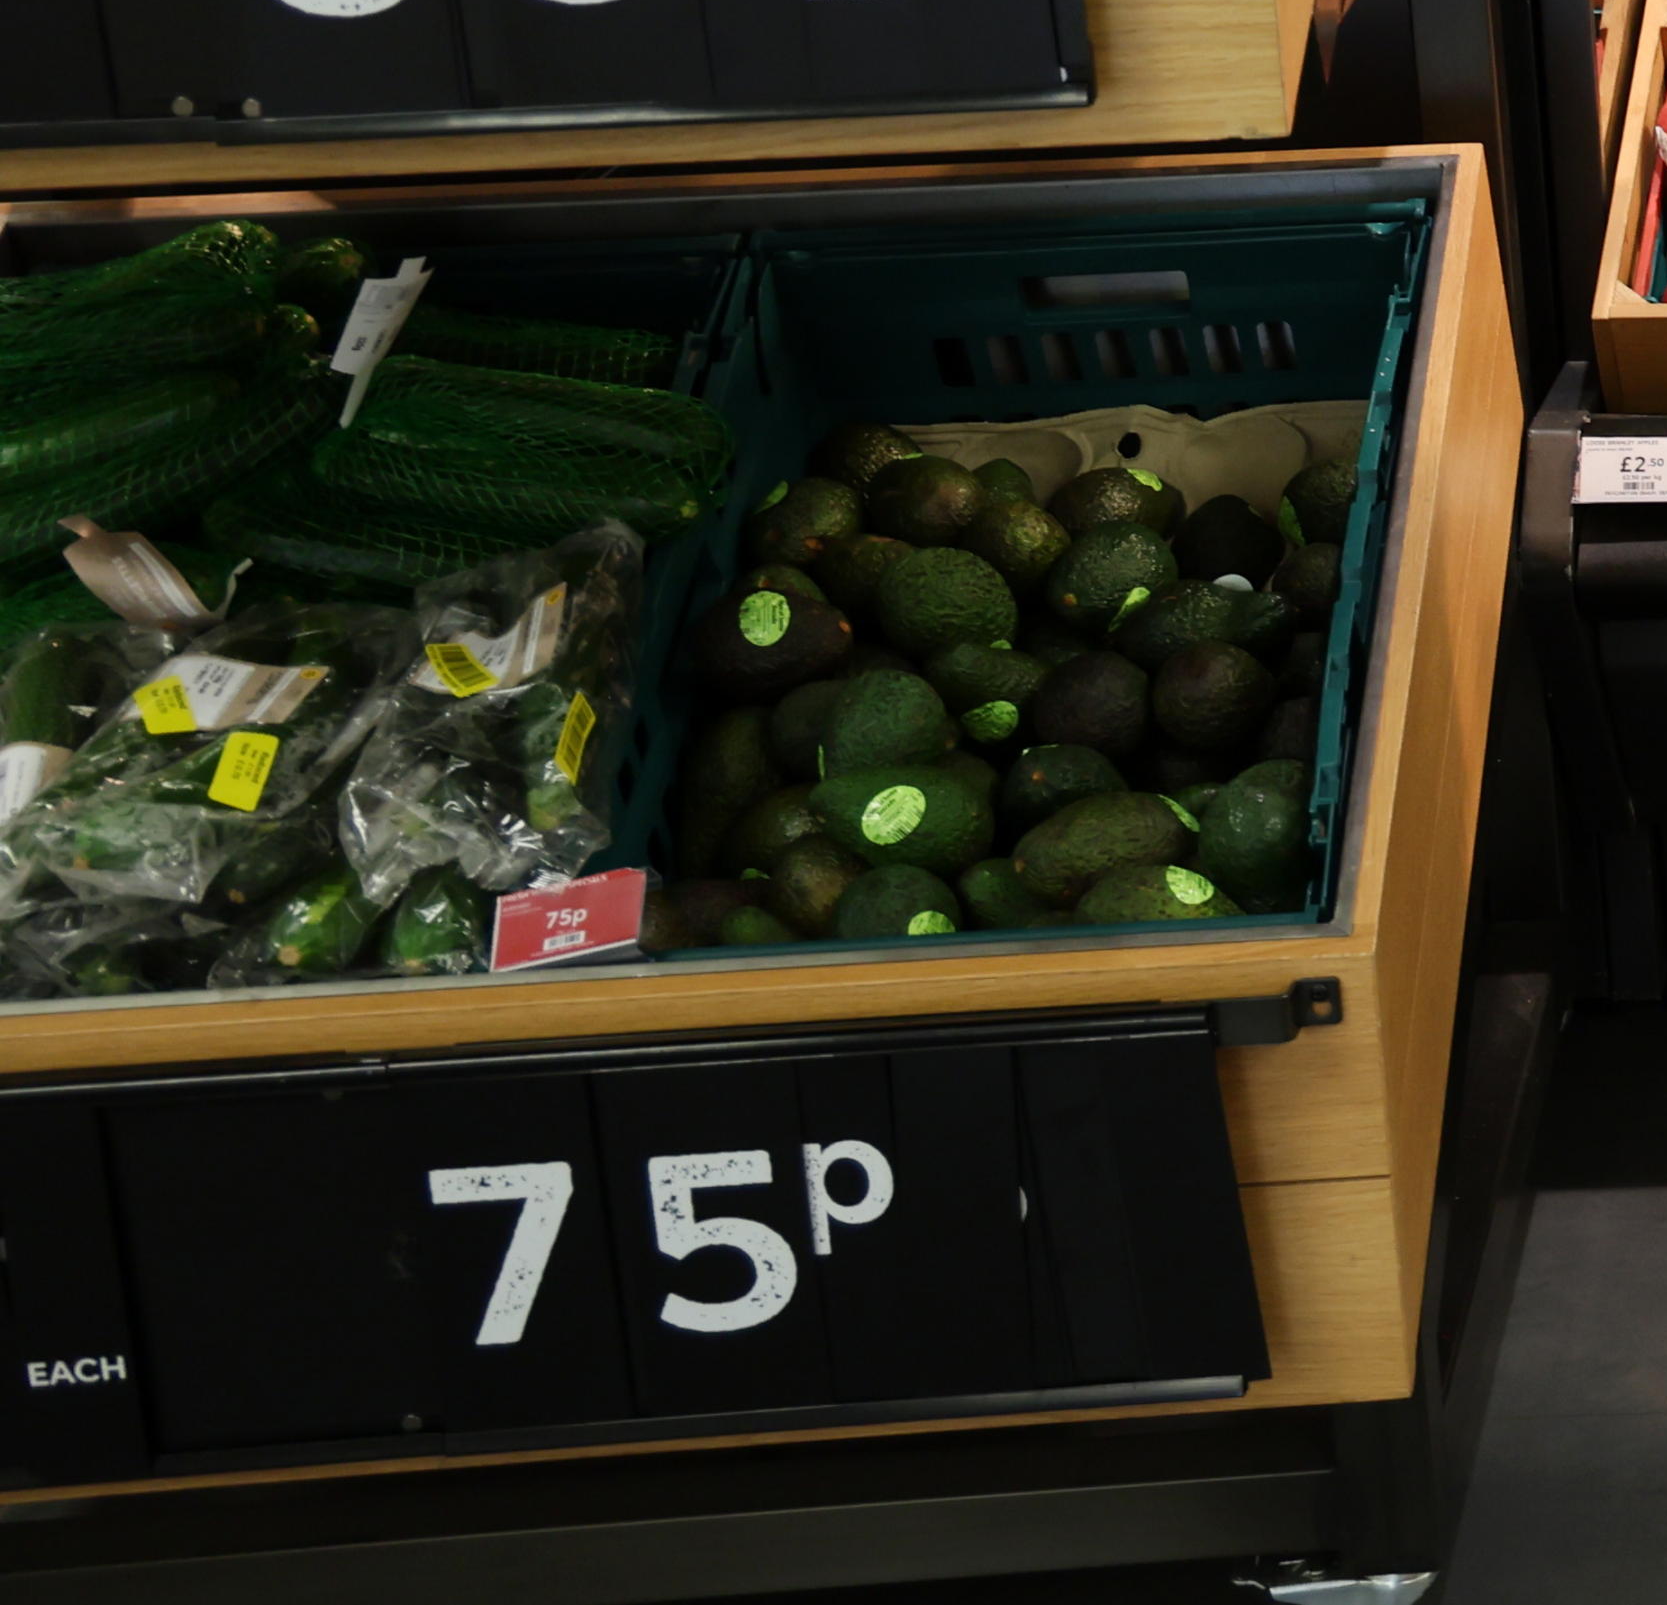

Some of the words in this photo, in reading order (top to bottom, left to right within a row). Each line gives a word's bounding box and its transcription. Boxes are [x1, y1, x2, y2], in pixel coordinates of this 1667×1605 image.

[1620, 455, 1665, 472] £2.50
[545, 908, 589, 930] 75p
[429, 1139, 894, 1346] 75p
[27, 1355, 127, 1388] EACH
